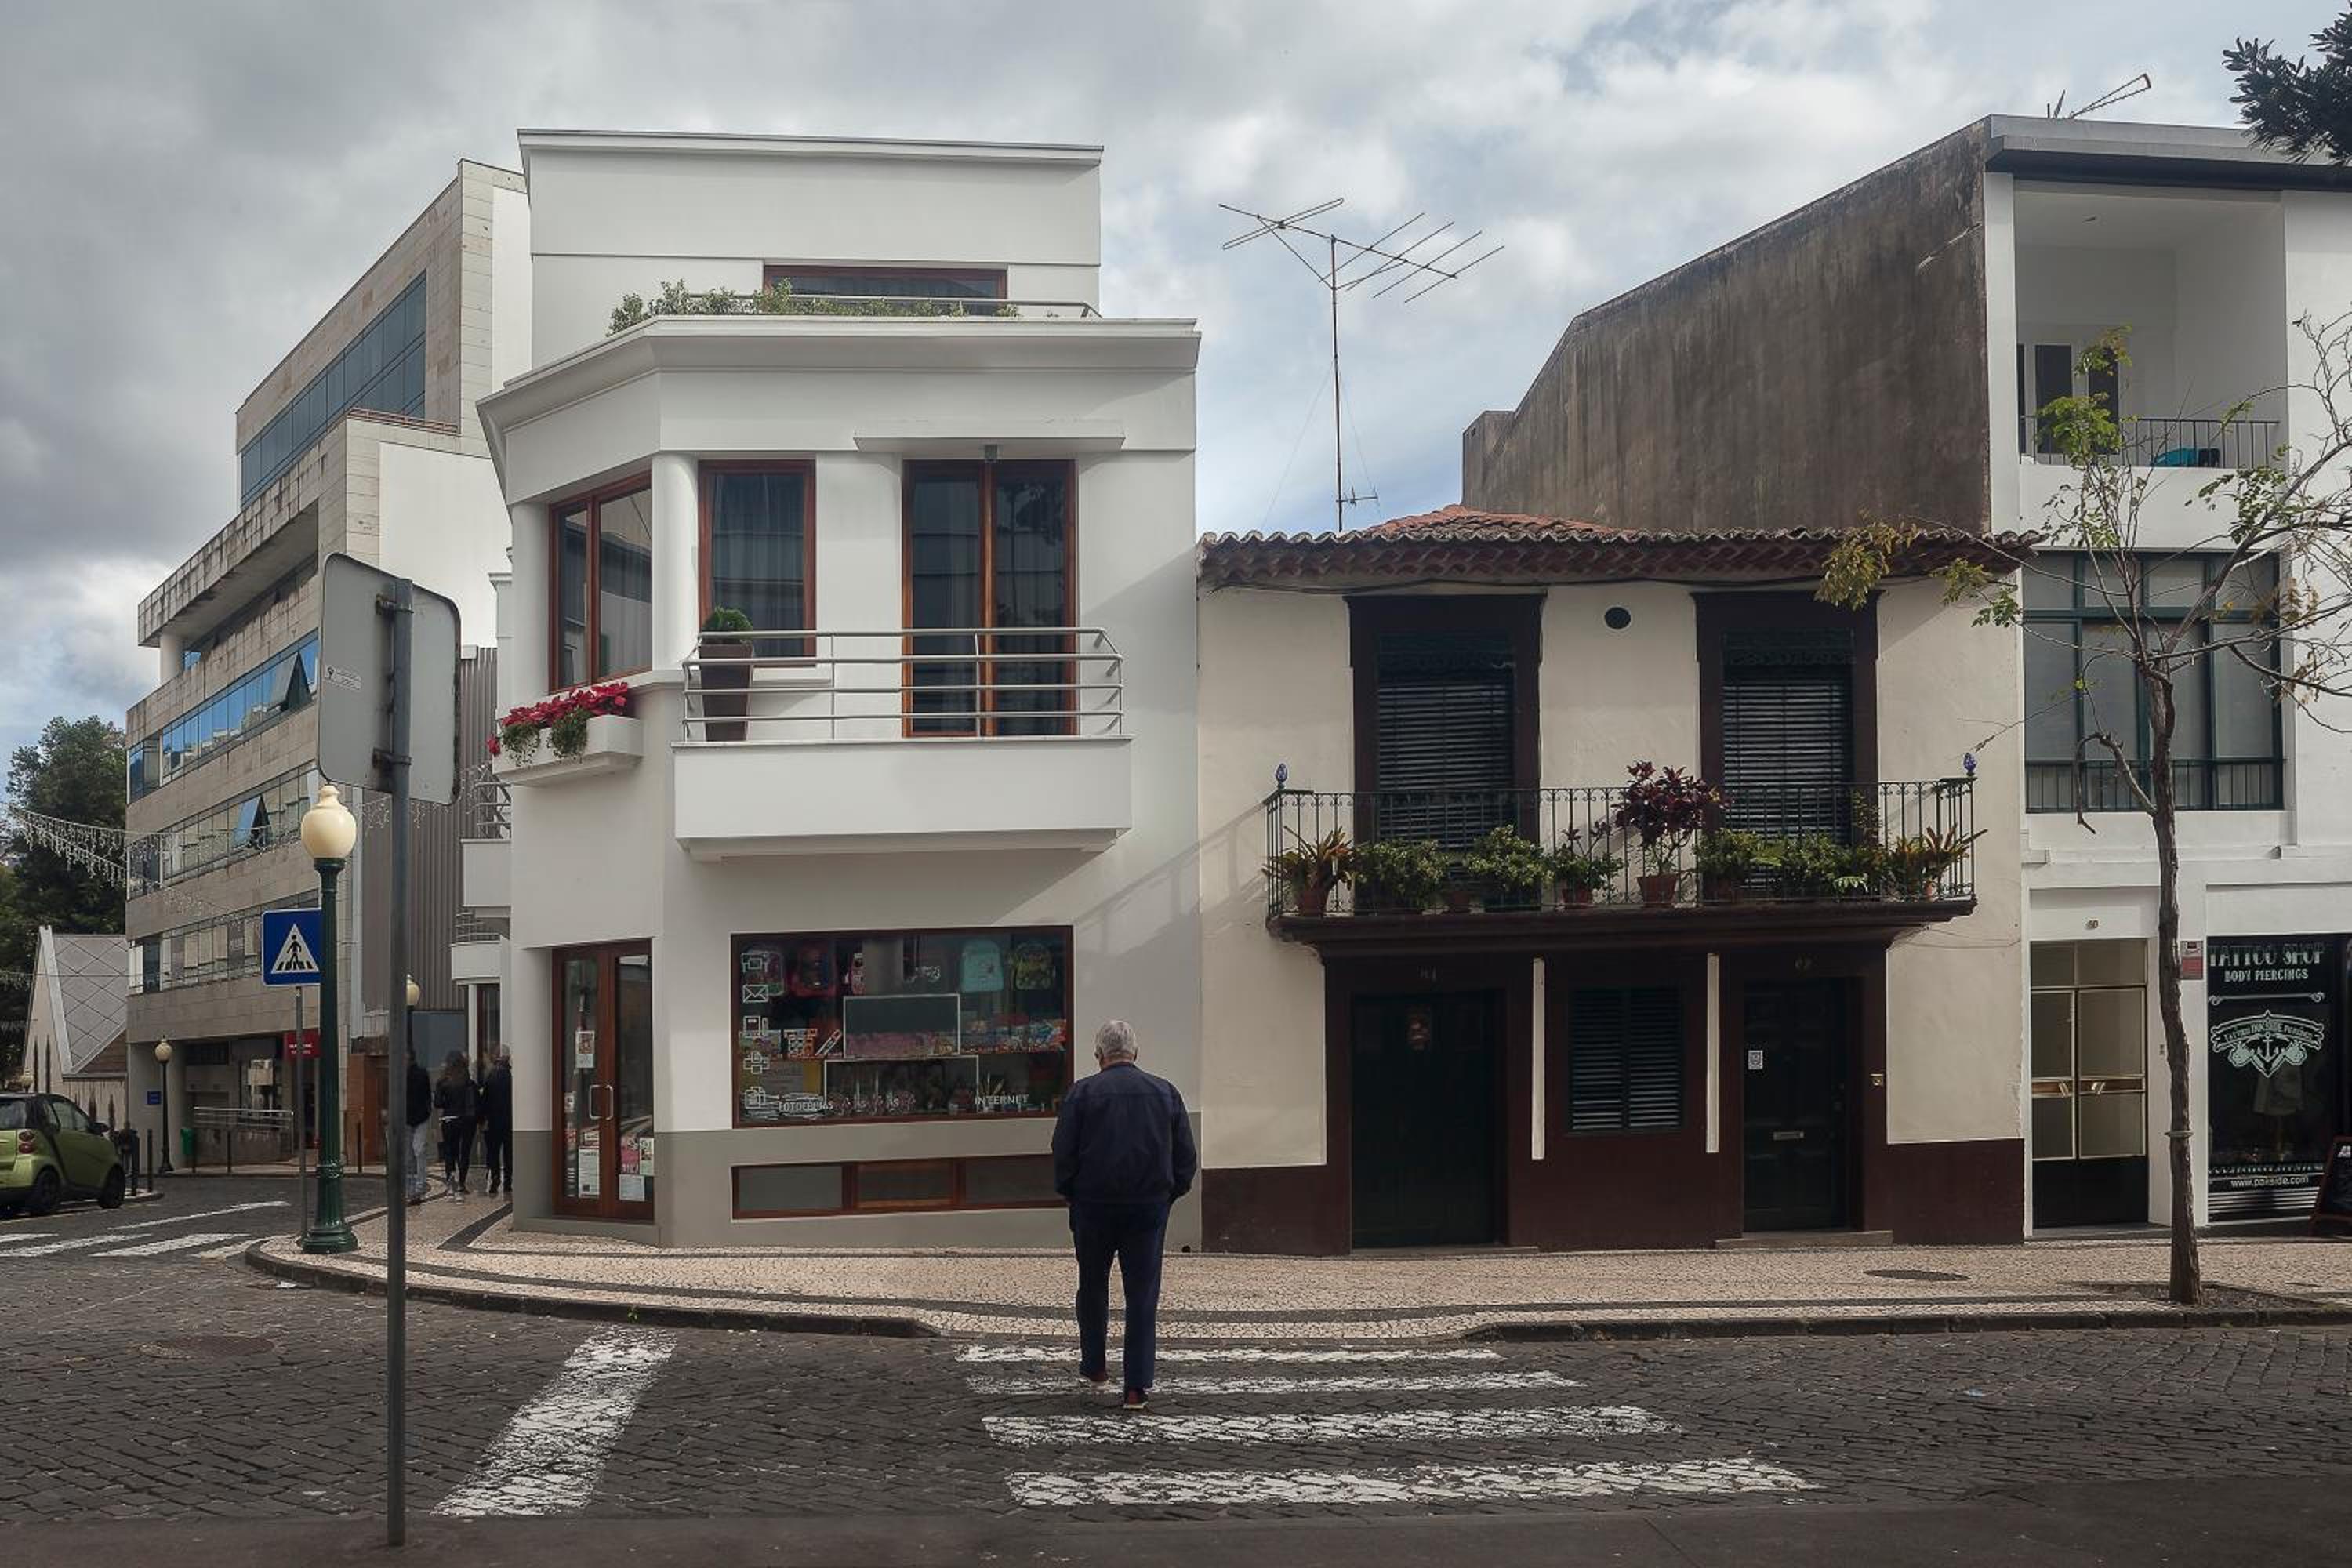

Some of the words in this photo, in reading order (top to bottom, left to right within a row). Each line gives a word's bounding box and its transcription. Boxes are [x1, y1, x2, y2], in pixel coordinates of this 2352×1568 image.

[2208, 945, 2277, 967] TATTOO
[2282, 942, 2325, 965] SHOP
[2223, 969, 2251, 982] BODY
[2255, 967, 2309, 982] PIERCINGS
[974, 1094, 1029, 1105] INTERNET
